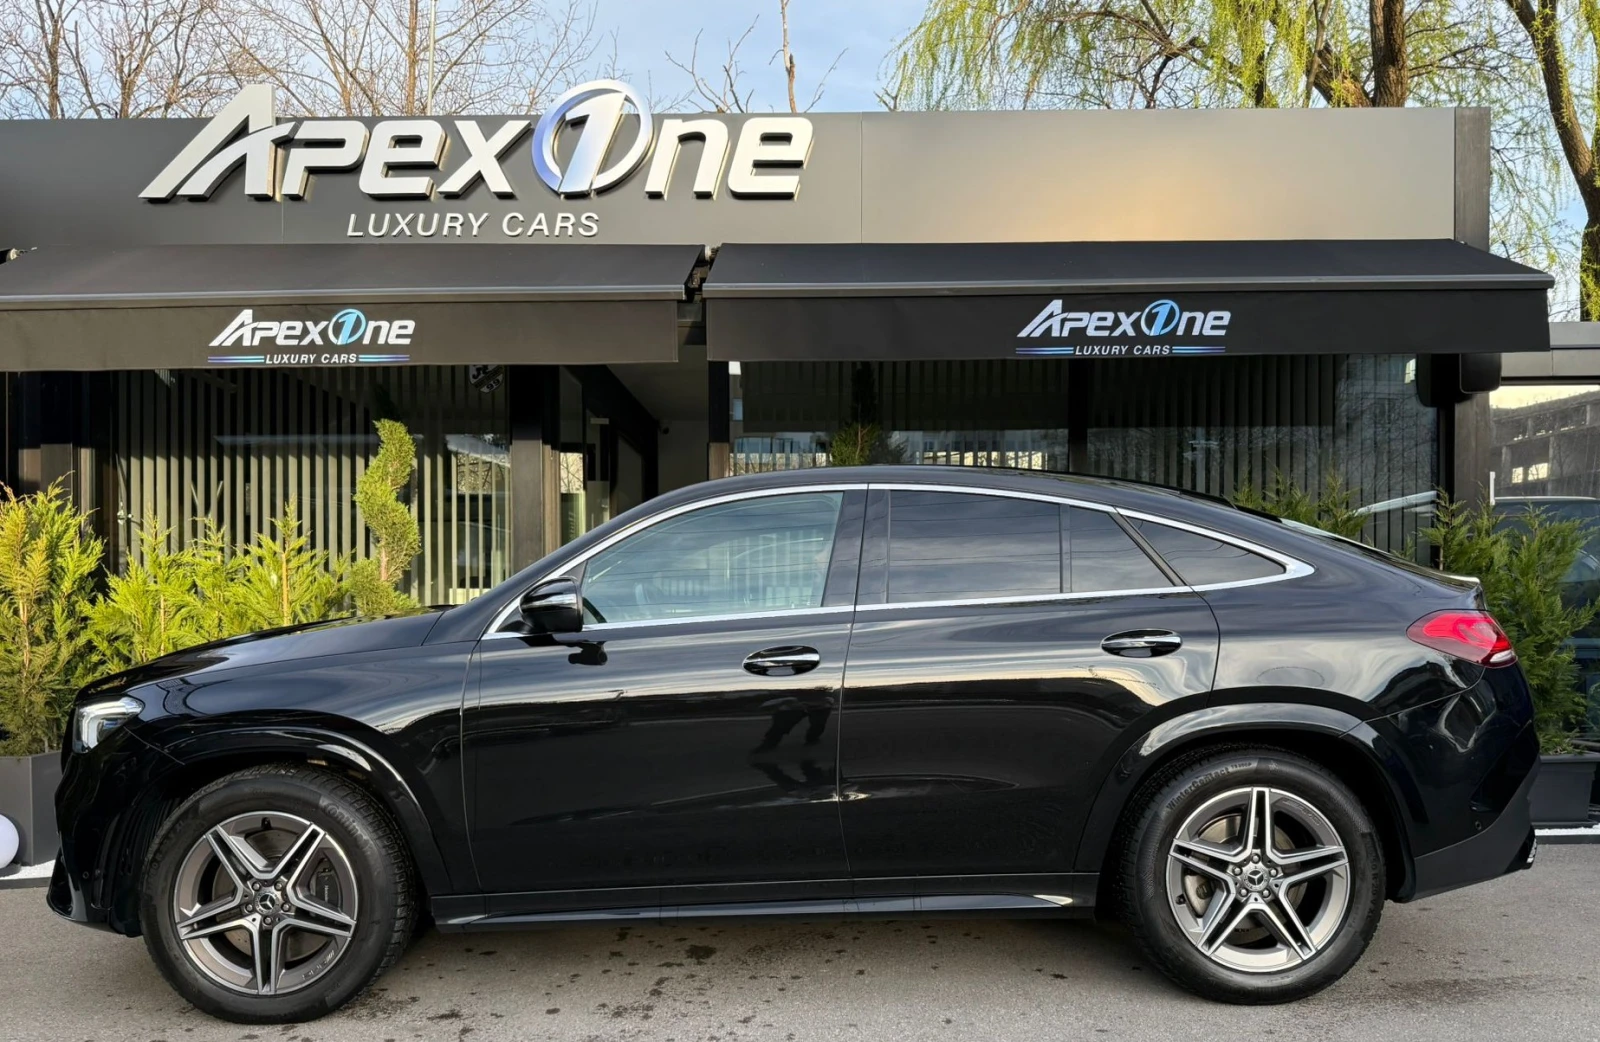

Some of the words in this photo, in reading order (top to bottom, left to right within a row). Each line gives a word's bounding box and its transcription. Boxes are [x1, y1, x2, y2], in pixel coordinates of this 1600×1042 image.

[347, 213, 490, 237] LUXURY
[502, 212, 599, 237] CARS
[265, 353, 316, 364] LUXURY
[321, 353, 357, 364] CARS
[1075, 345, 1129, 355] LUXURY
[1133, 345, 1170, 355] CARS
[1166, 767, 1230, 810] WinterContact
